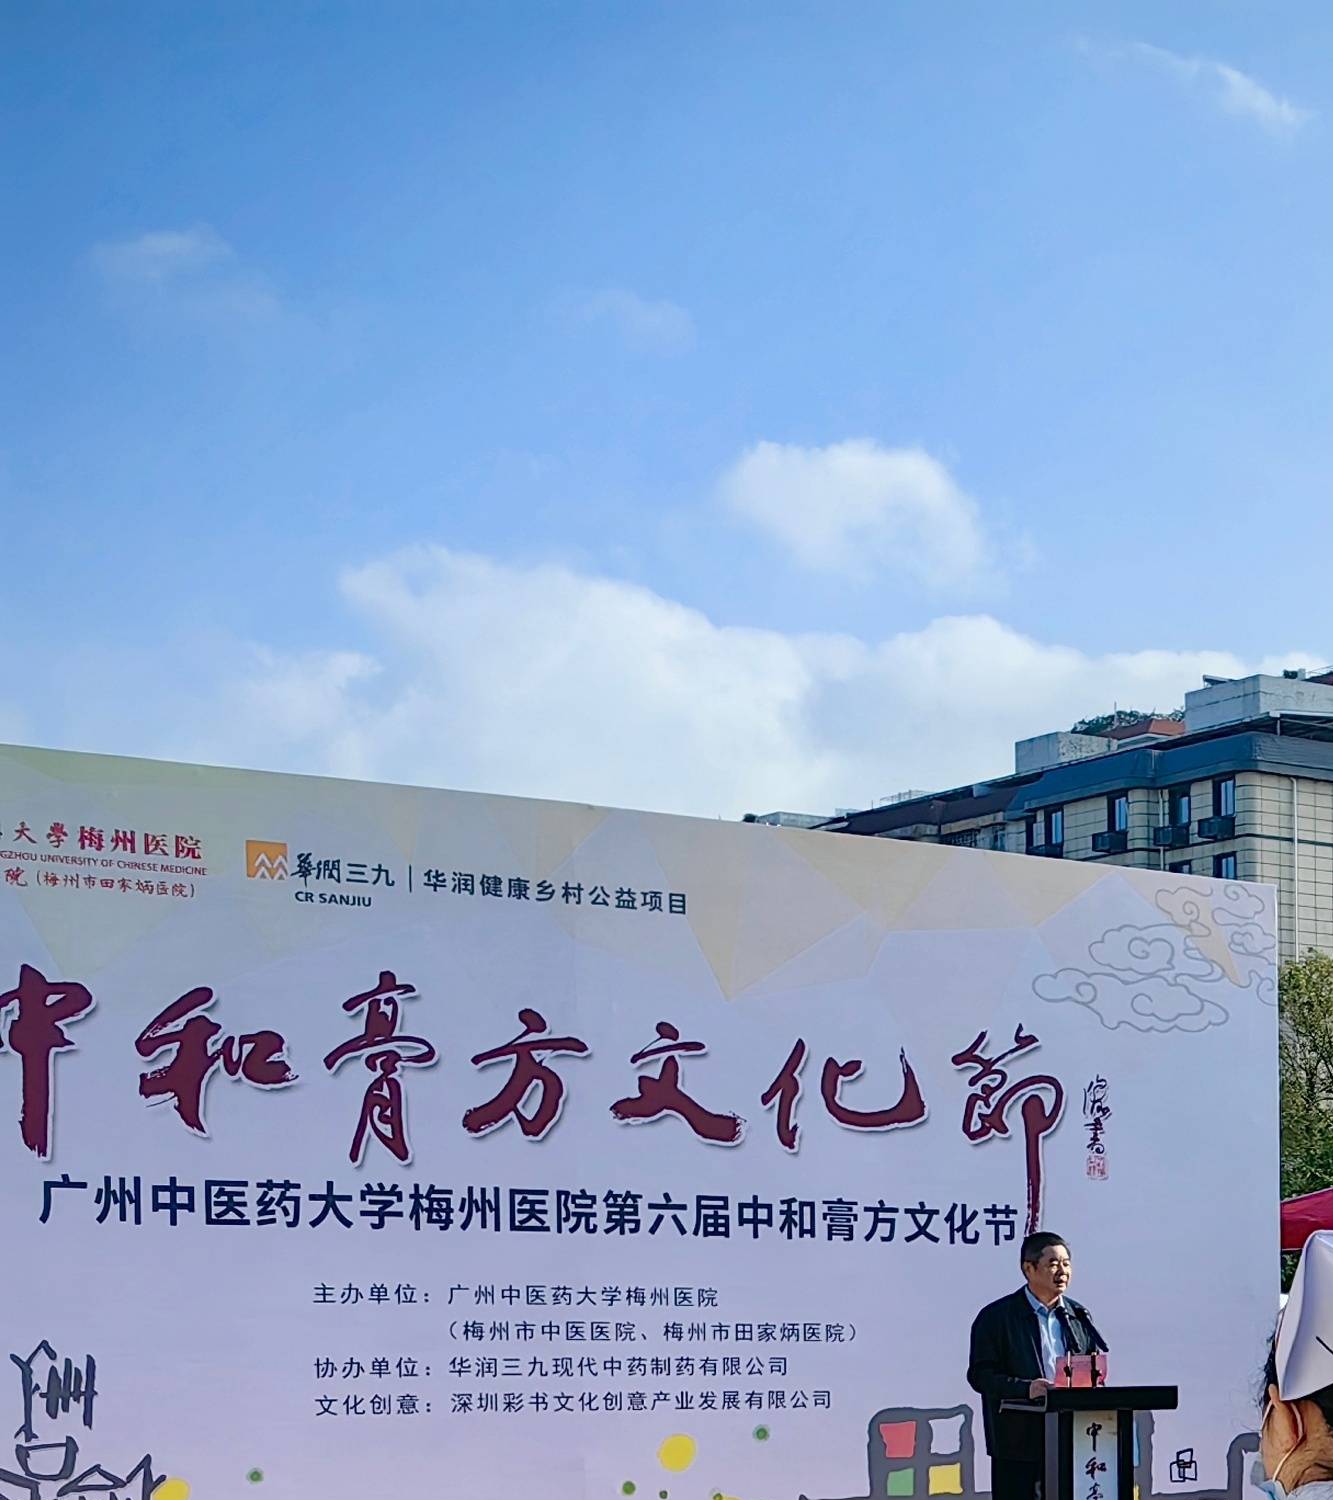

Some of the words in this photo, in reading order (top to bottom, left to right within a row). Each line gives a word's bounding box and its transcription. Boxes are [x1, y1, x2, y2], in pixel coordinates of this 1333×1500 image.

[0, 821, 202, 860] 大學梅州医院
[40, 853, 98, 868] UNIVERSITY
[100, 859, 114, 868] OF
[117, 861, 158, 873] CHINESE
[160, 864, 208, 876] MEDICINE
[295, 891, 314, 904] CR
[318, 892, 372, 907] SANJIU
[423, 868, 687, 915] 华润健康乡村公益项目
[39, 1175, 1018, 1247] 广州中医药大学梅州医院第六届中和膏方文化节
